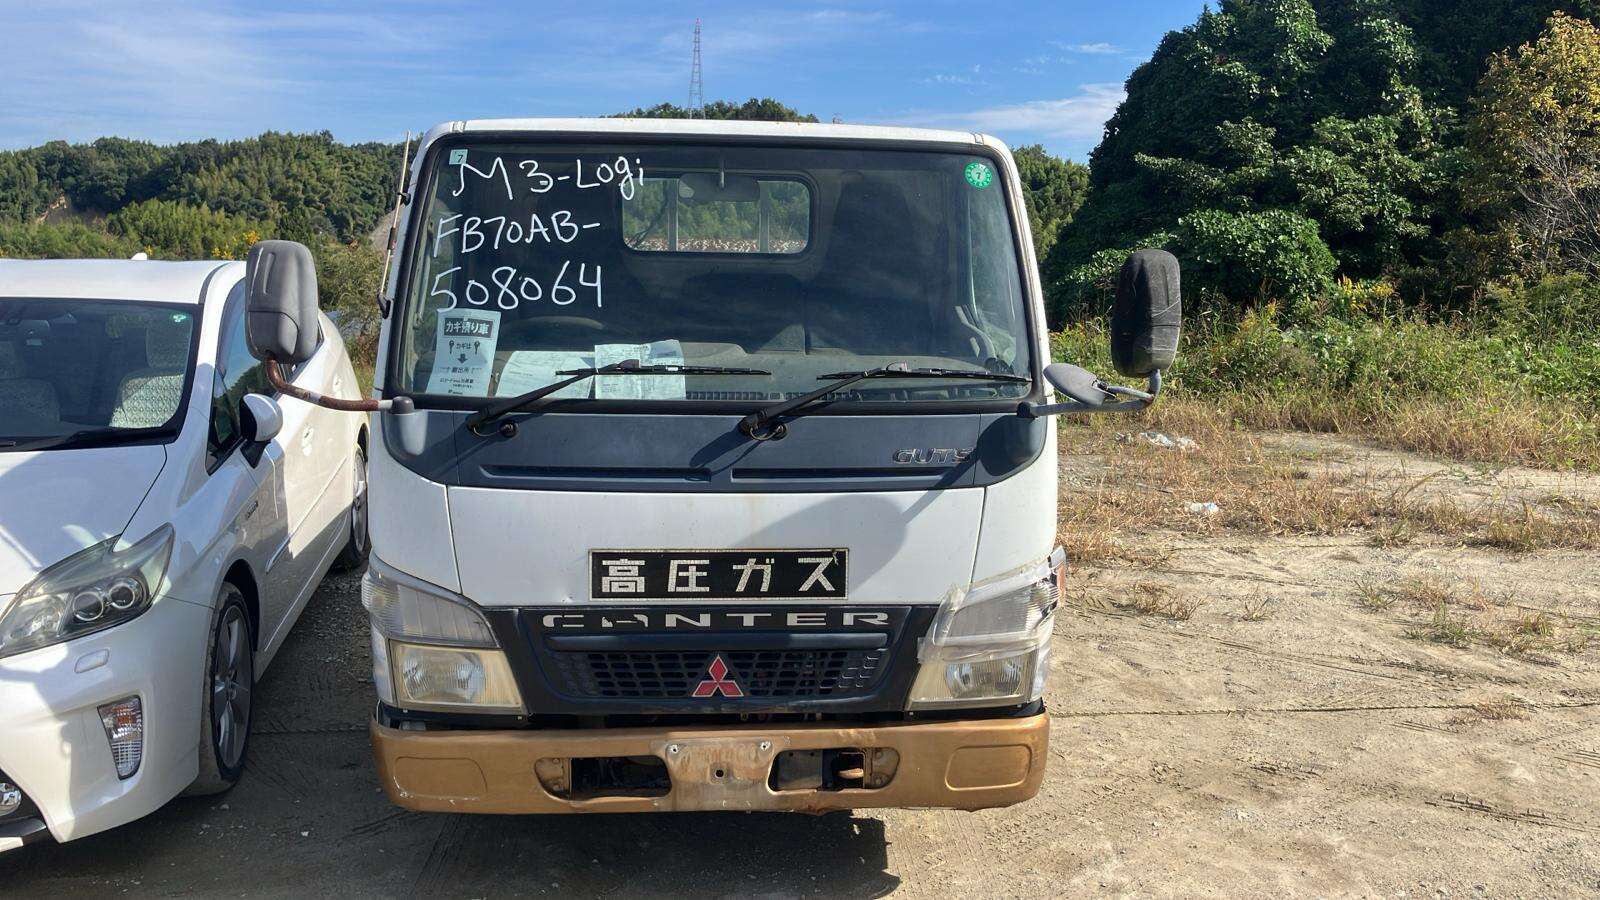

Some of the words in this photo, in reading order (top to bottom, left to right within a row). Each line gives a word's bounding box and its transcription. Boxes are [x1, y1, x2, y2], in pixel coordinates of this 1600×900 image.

[433, 210, 601, 258] FB70AB-
[431, 260, 602, 312] 508064
[893, 447, 974, 464] GUTS
[601, 557, 837, 593] 高圧ガス
